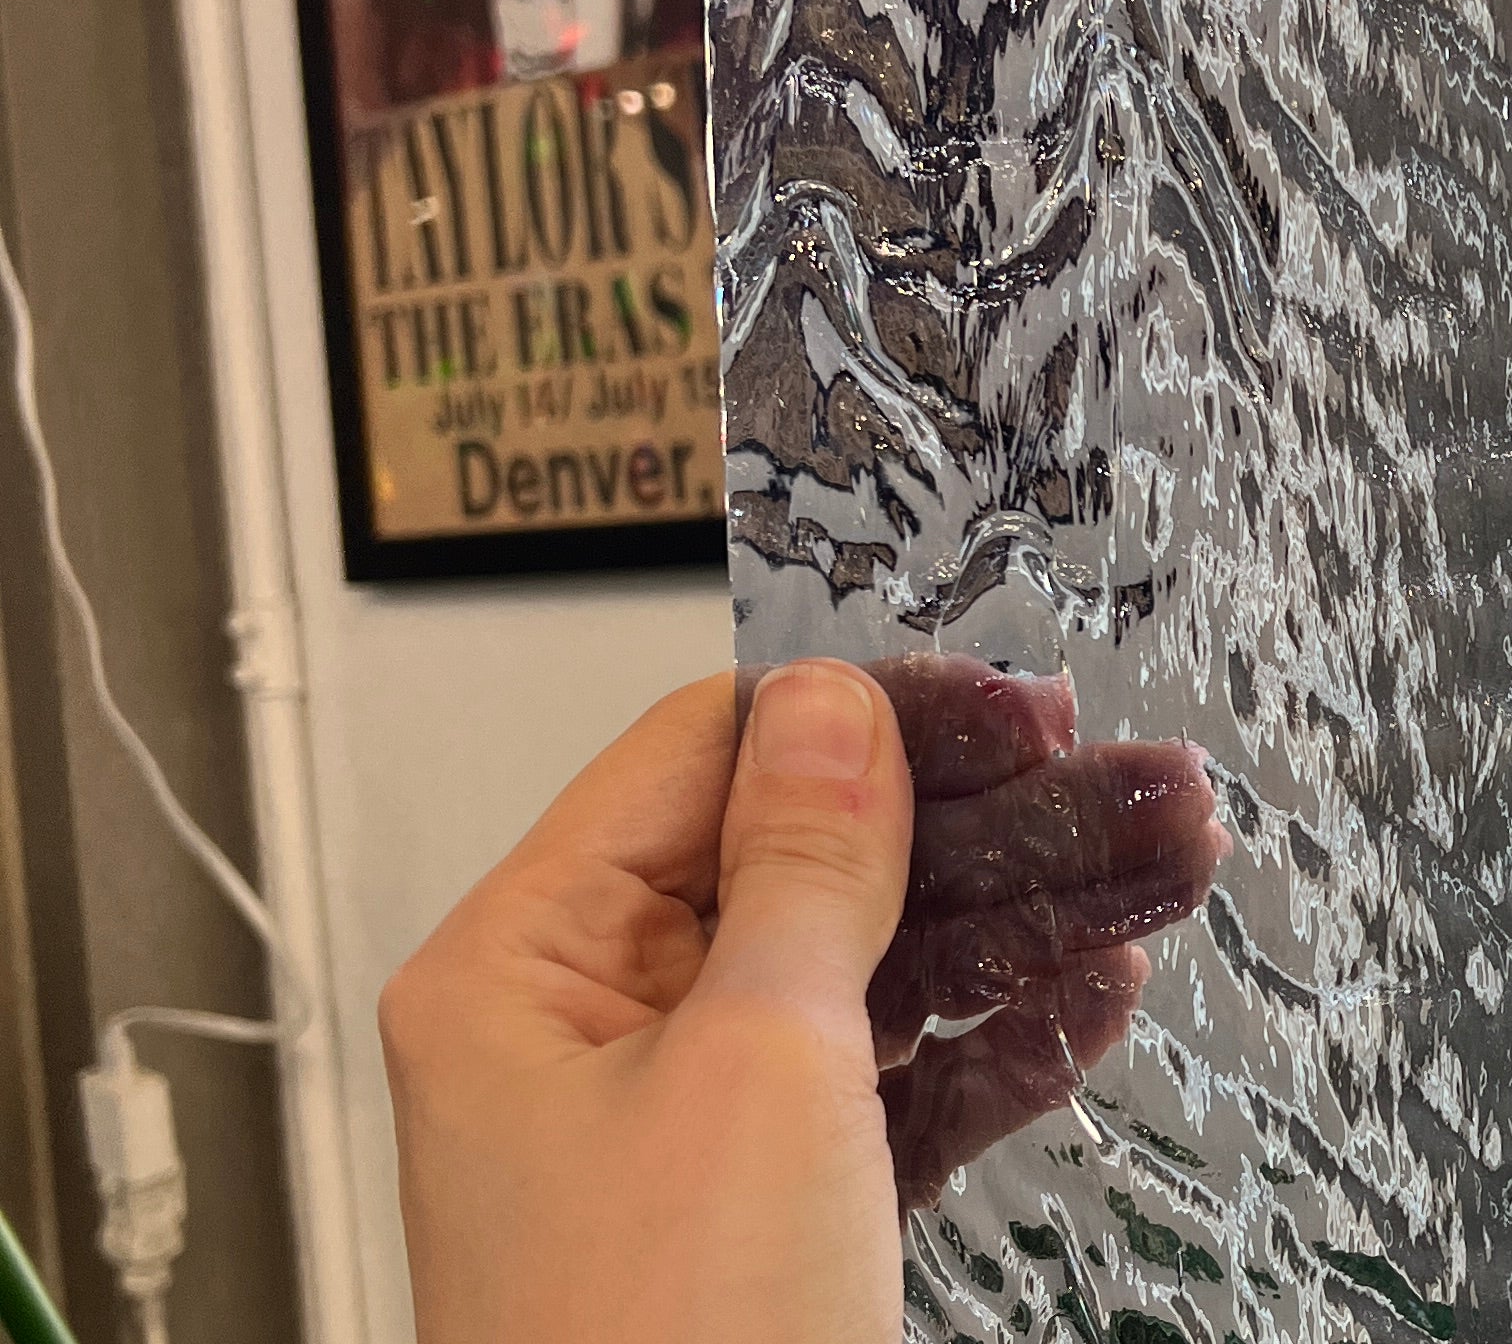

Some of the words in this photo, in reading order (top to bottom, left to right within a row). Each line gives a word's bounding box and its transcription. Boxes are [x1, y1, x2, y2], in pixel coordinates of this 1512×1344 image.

[366, 292, 499, 390] THE
[510, 267, 696, 373] ERAS
[586, 367, 669, 424] July
